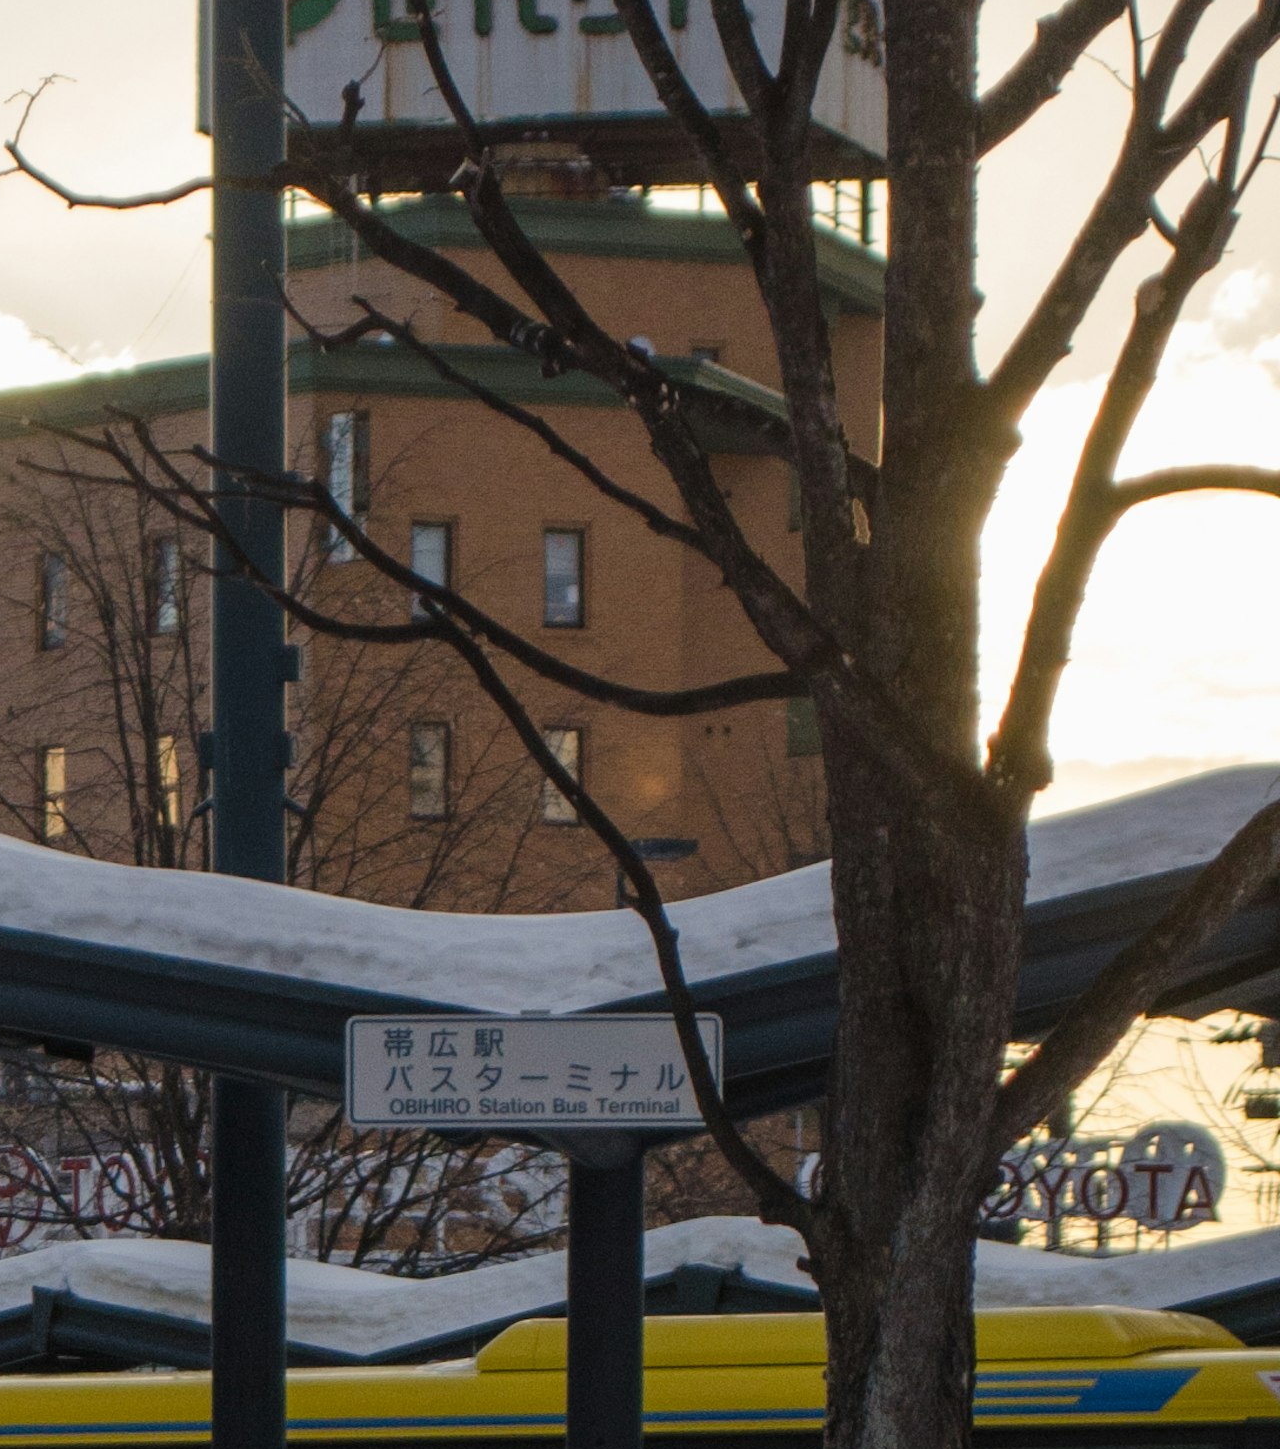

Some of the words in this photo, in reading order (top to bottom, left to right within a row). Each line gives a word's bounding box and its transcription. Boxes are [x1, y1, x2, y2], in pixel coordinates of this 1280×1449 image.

[383, 1027, 504, 1058] 帯広駅
[384, 1062, 685, 1093] バスターミナル
[389, 1098, 471, 1115] OBIHIRO
[479, 1097, 546, 1115] Station
[553, 1098, 588, 1114] Bus
[597, 1097, 680, 1114] Terminal
